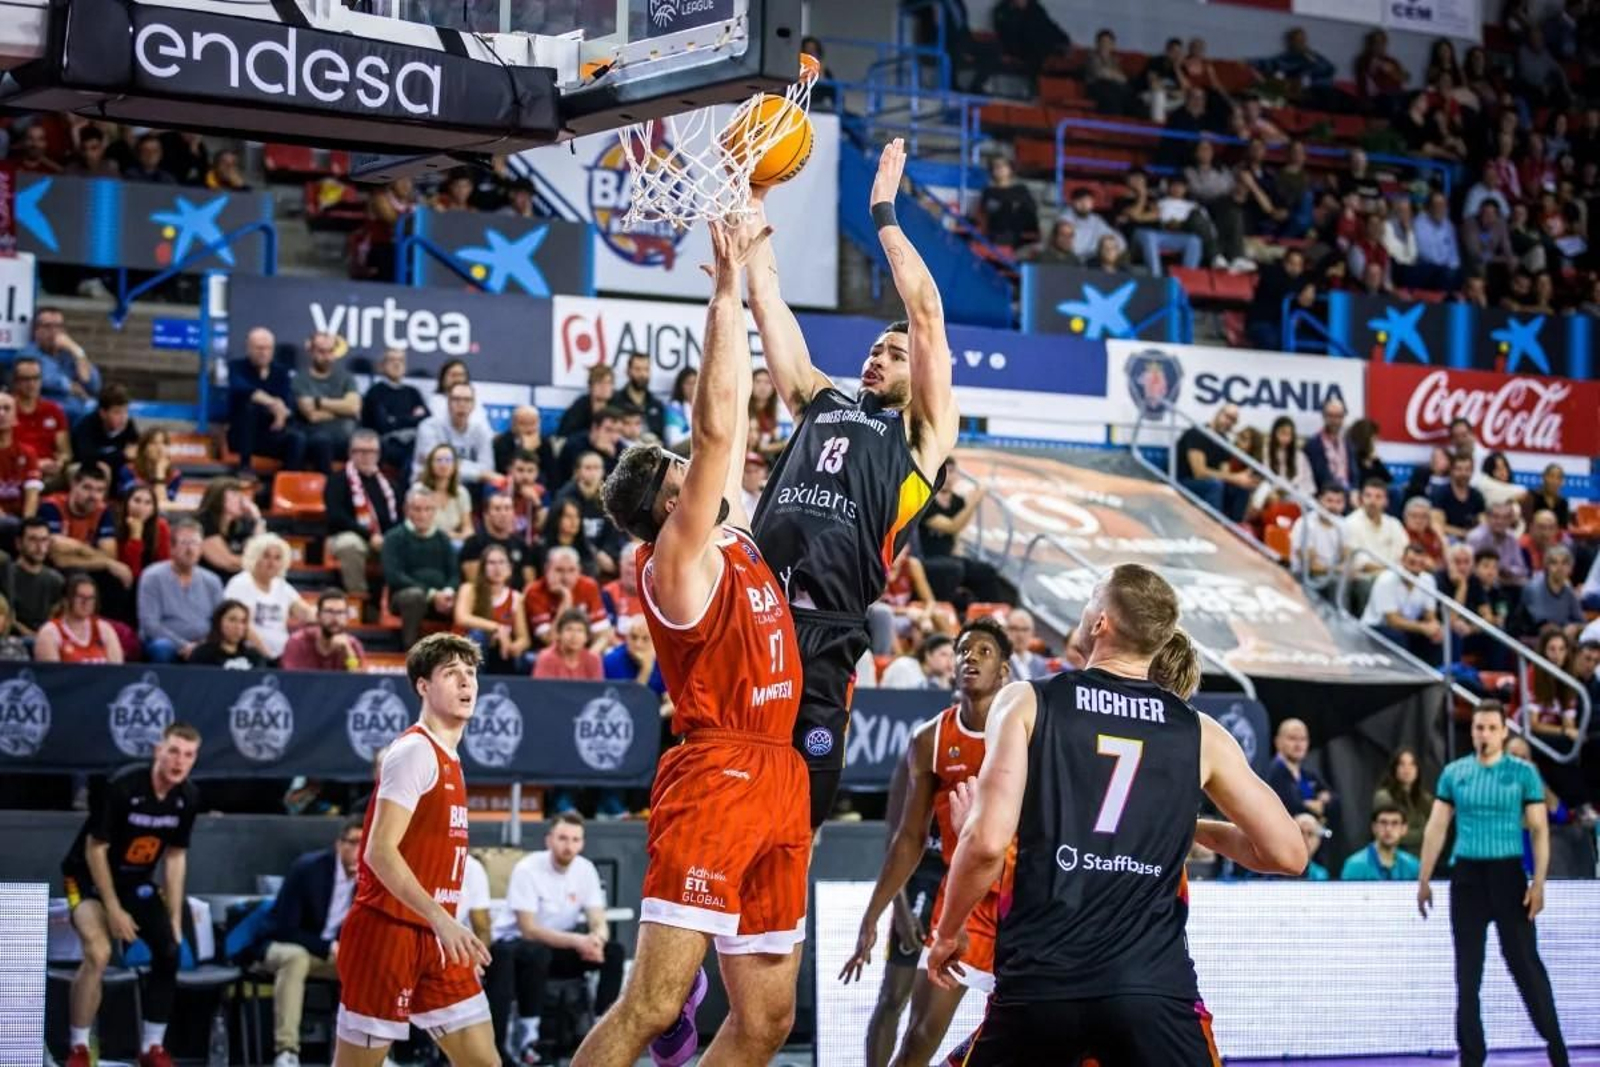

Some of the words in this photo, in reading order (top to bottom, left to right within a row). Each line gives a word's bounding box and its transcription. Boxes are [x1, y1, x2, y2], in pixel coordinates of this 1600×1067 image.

[135, 23, 442, 116] endesa
[1194, 373, 1348, 414] SCANIA
[1405, 369, 1572, 449] Coca-Cola
[815, 436, 850, 474] 13
[777, 482, 857, 519] axilaris
[1075, 685, 1166, 723] RICHTER
[114, 706, 171, 727] BAXI
[235, 709, 290, 730] BAXI
[352, 712, 406, 733] BAXI
[467, 716, 520, 737] BAXI
[580, 720, 630, 740] BAXI
[1093, 733, 1144, 834] 7
[1082, 853, 1162, 877] Staffbase
[684, 877, 709, 893] ETL
[681, 891, 726, 909] GLOBAL
